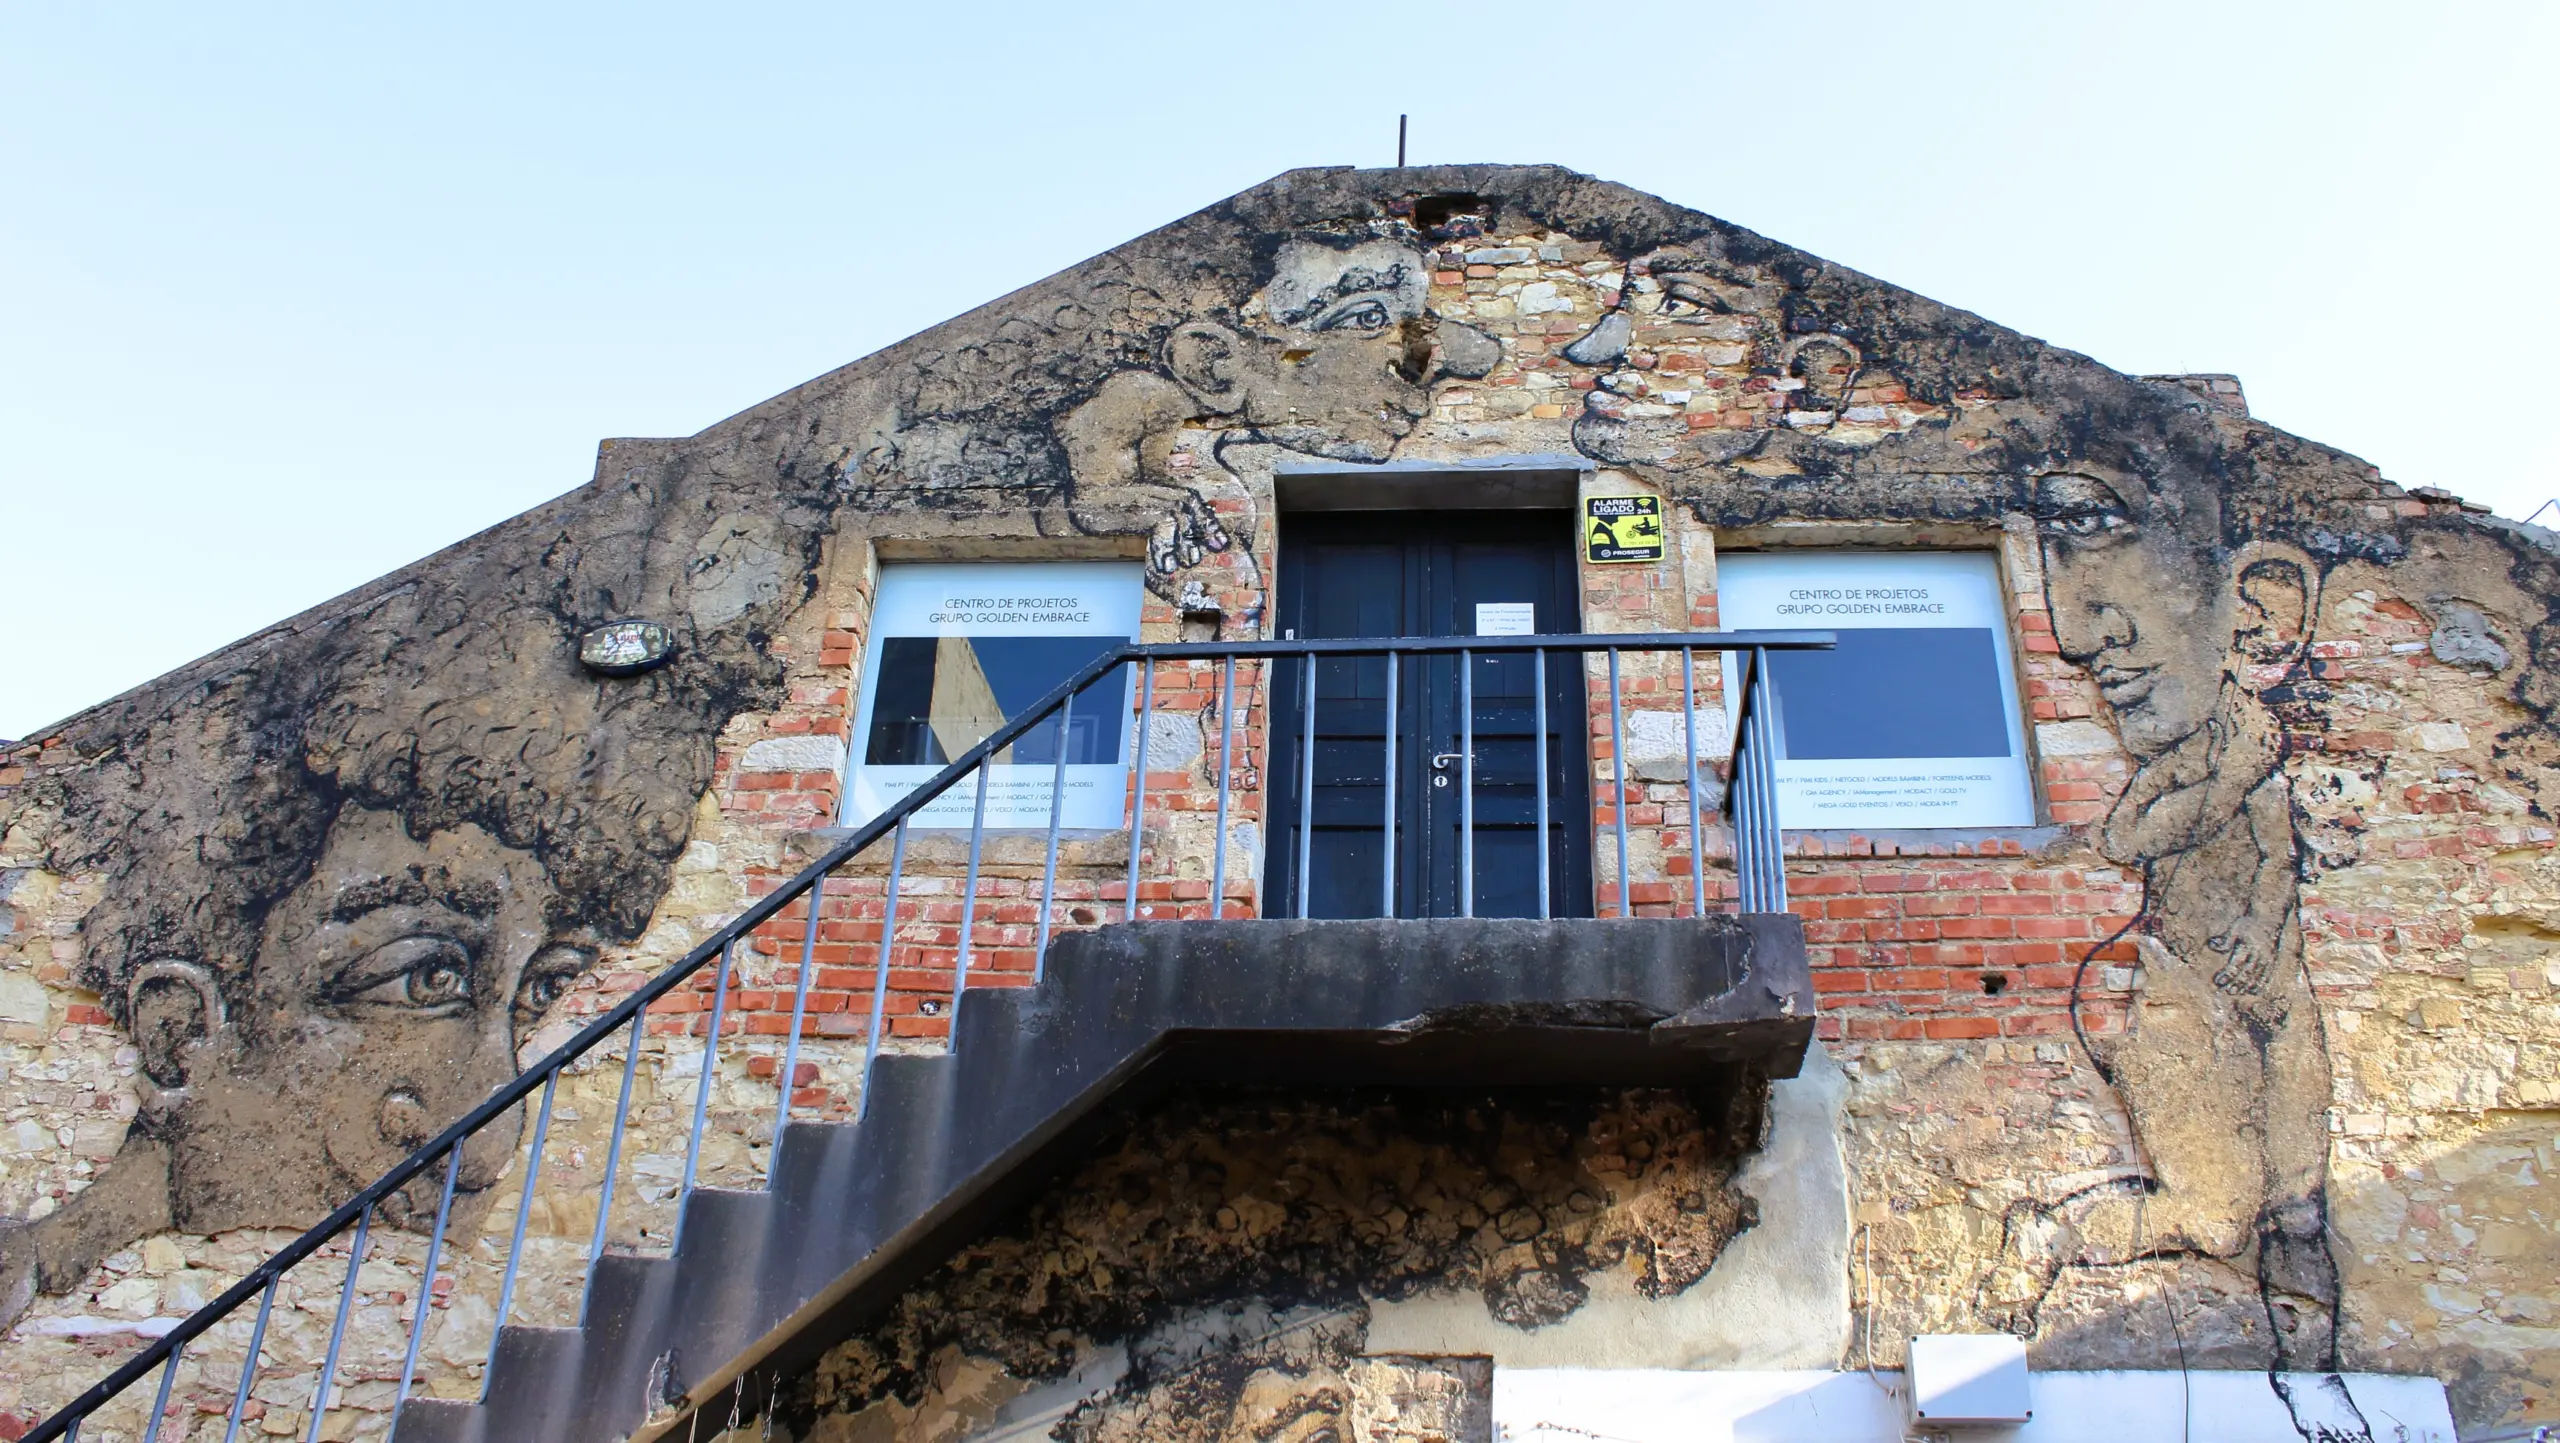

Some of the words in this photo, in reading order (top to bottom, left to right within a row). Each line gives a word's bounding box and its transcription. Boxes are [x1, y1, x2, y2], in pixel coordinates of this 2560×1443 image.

[1593, 505, 1635, 513] LIGADO
[1789, 589, 1842, 600] CENTRO
[1845, 589, 1862, 600] DE
[1865, 589, 1929, 600] PROJETOS
[945, 598, 995, 609] CENTRO
[997, 598, 1014, 609] DE
[1017, 598, 1078, 609] PROJETOS
[1776, 604, 1823, 615] GRUPO
[1826, 603, 1881, 615] GOLDEN
[1884, 603, 1945, 614] EMBRACE
[929, 612, 973, 623] GRUPO
[977, 612, 1029, 623] GOLDEN
[1032, 611, 1091, 623] EMBRACE
